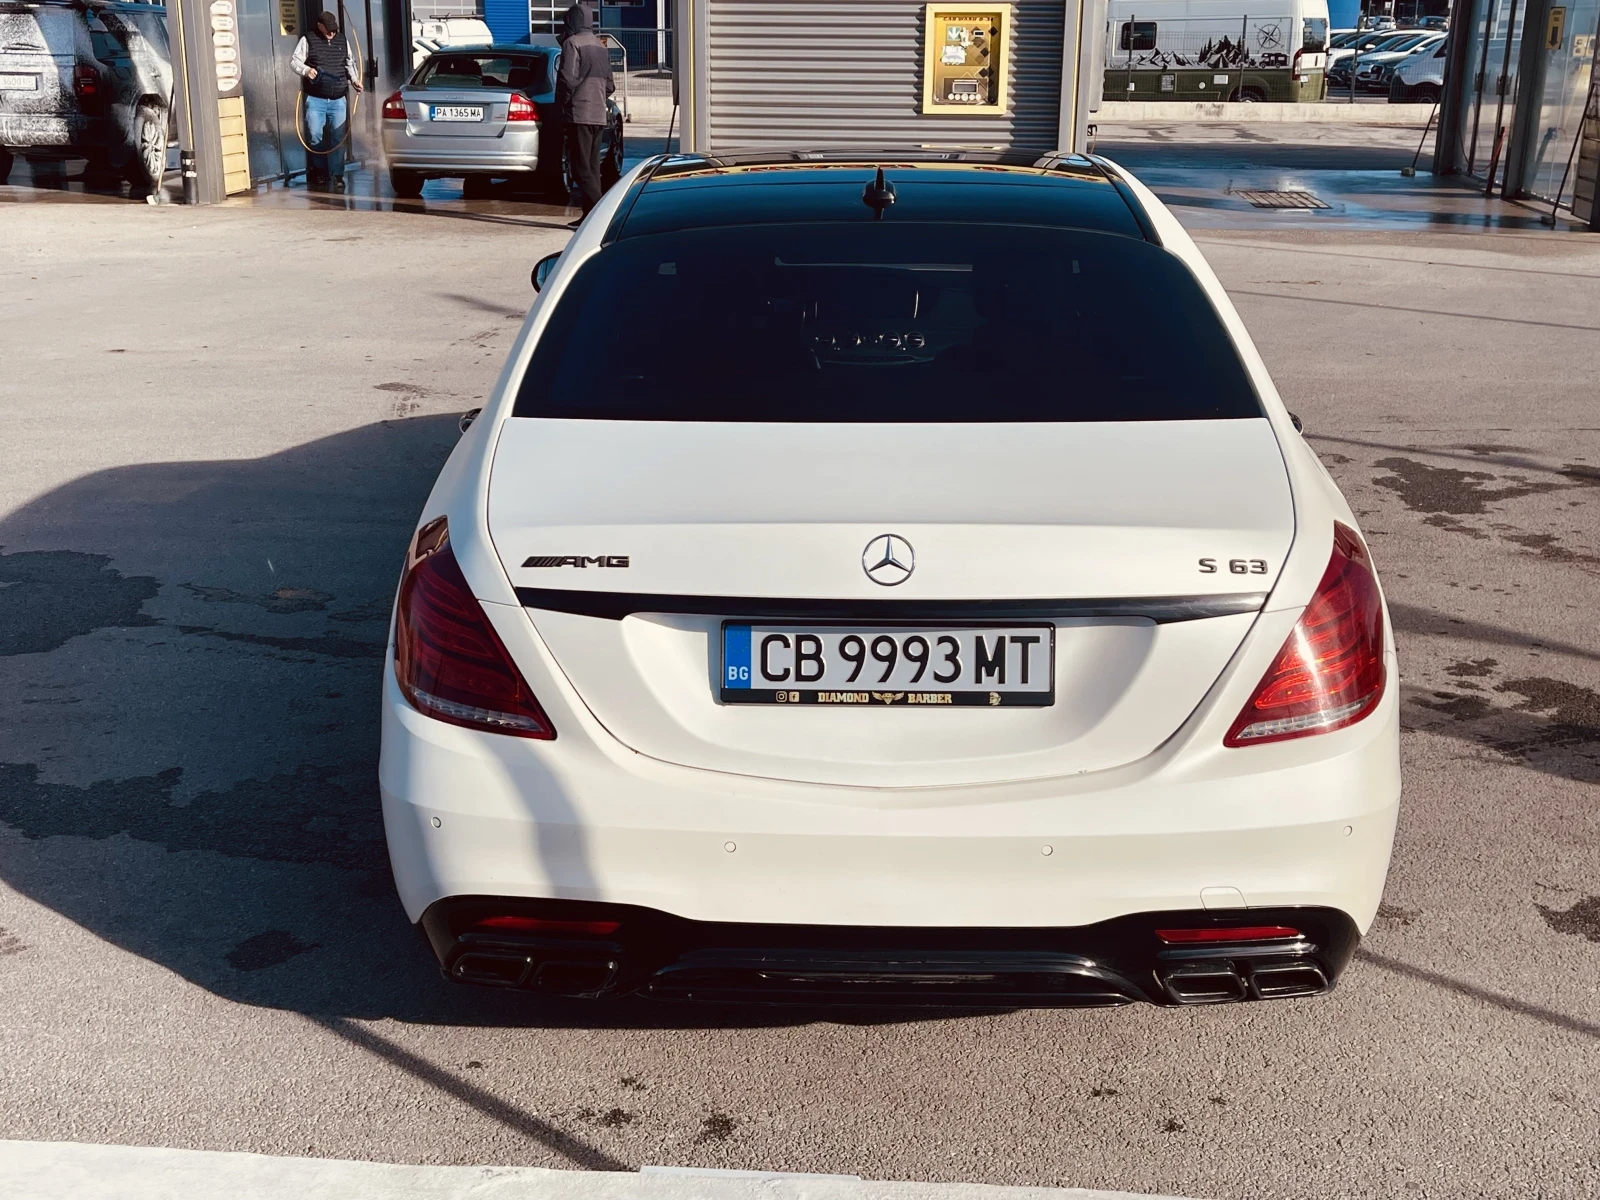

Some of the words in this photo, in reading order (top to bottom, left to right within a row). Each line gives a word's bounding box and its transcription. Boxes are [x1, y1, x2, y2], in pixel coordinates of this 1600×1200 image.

[436, 108, 447, 117] PA
[449, 108, 469, 118] 1365
[555, 556, 629, 568] AMG
[1198, 558, 1218, 573] S
[1228, 559, 1268, 574] 63
[759, 633, 826, 682] CB
[838, 634, 962, 684] 9993
[974, 635, 1041, 685] MT
[727, 666, 749, 681] BG
[817, 692, 870, 703] DIAMOND
[907, 693, 953, 704] BARBER
